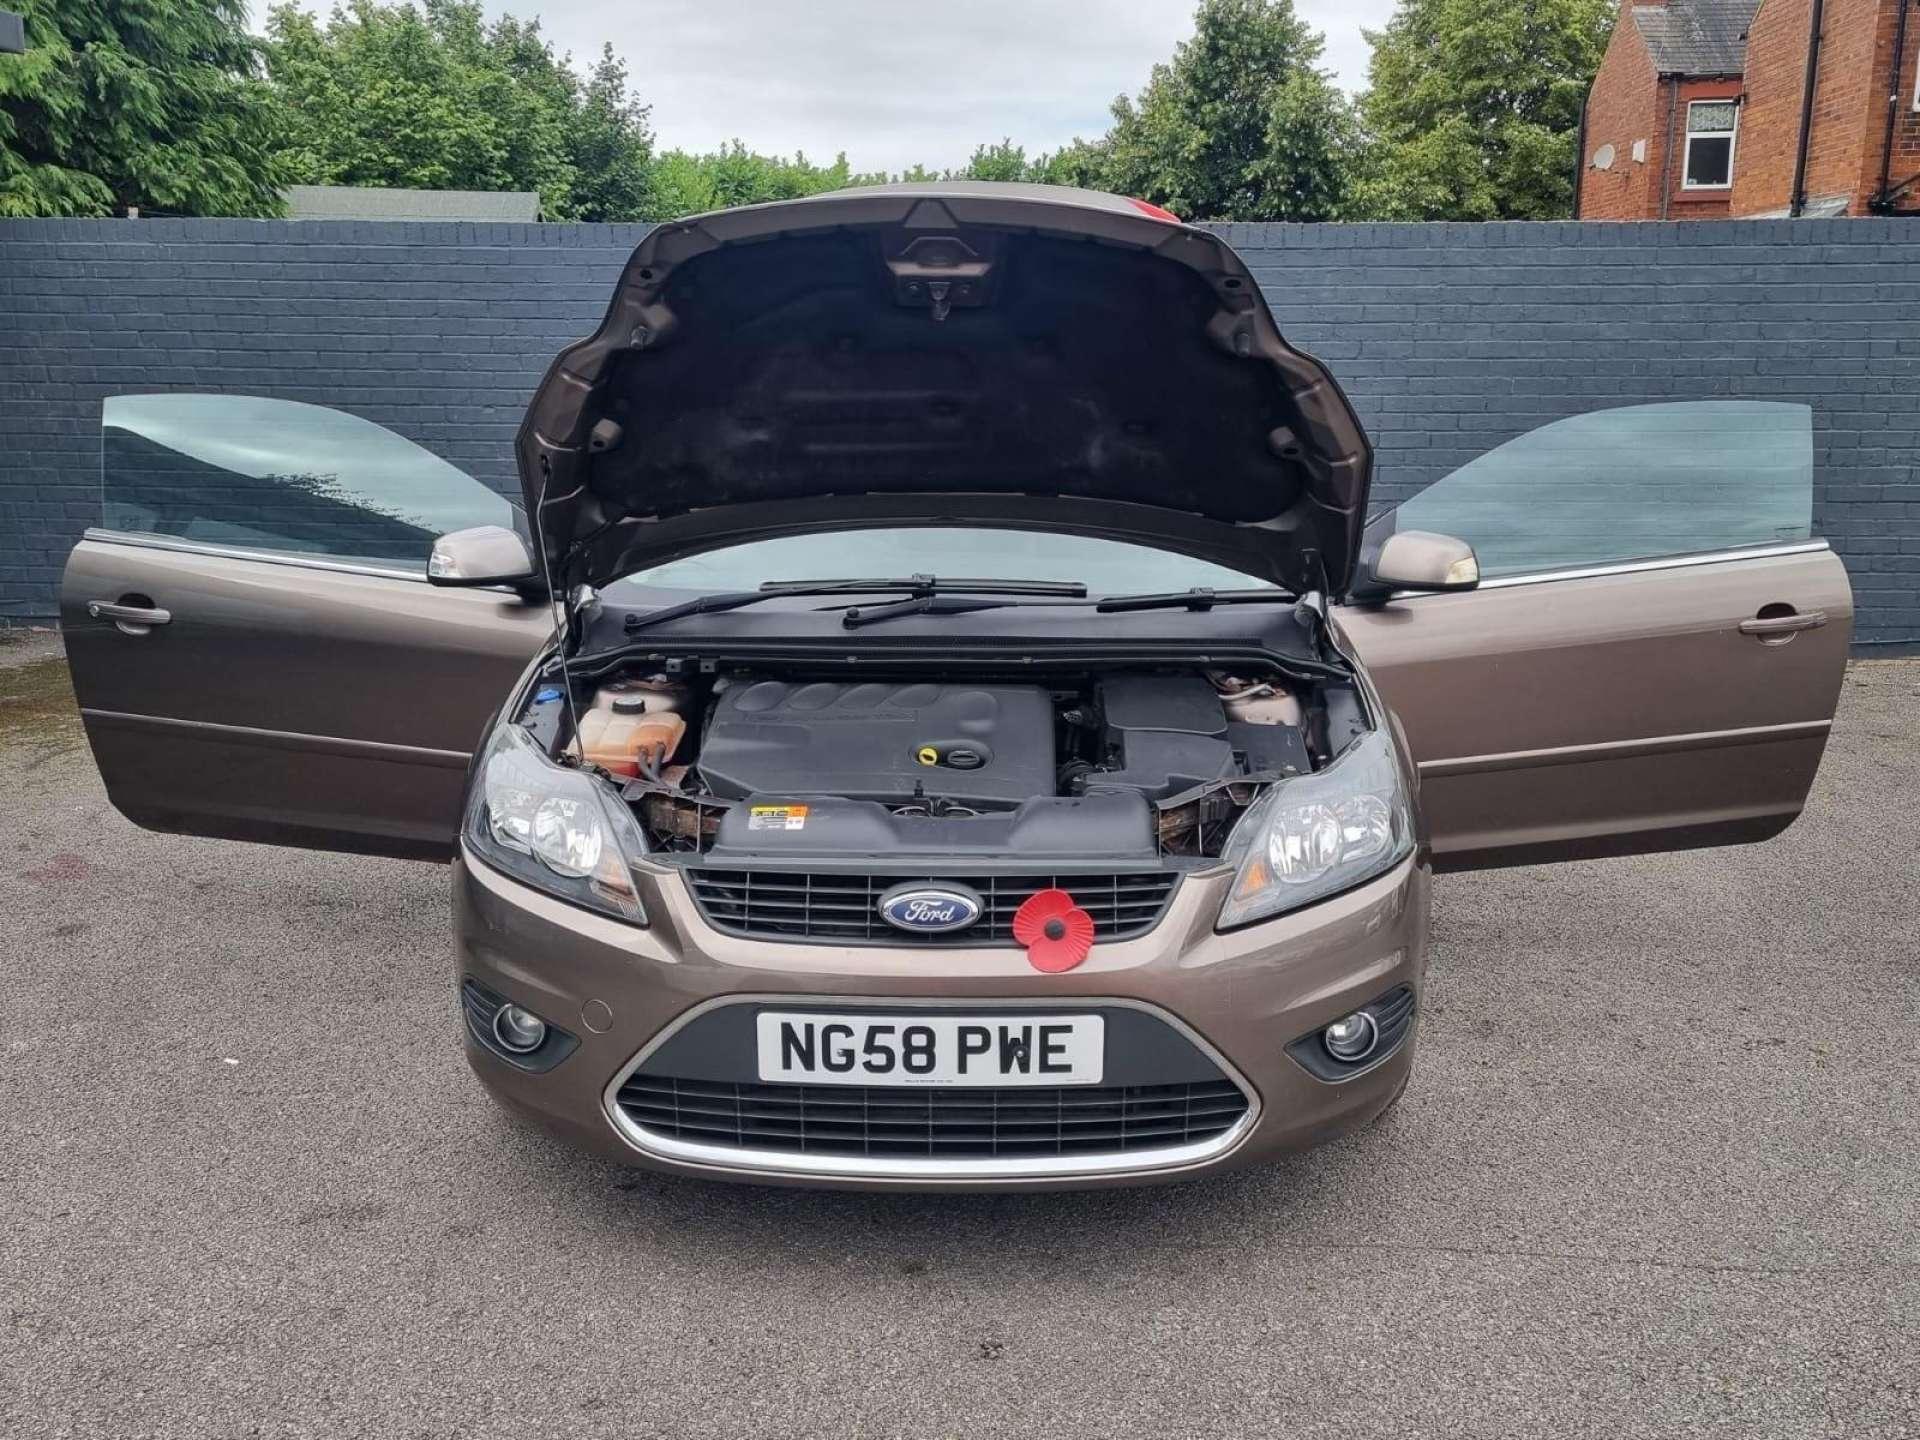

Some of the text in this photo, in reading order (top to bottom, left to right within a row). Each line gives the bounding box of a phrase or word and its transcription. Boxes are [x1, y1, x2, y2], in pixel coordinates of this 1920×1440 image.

[904, 900, 955, 921] Ford
[780, 1022, 1073, 1075] NG58 PWE
